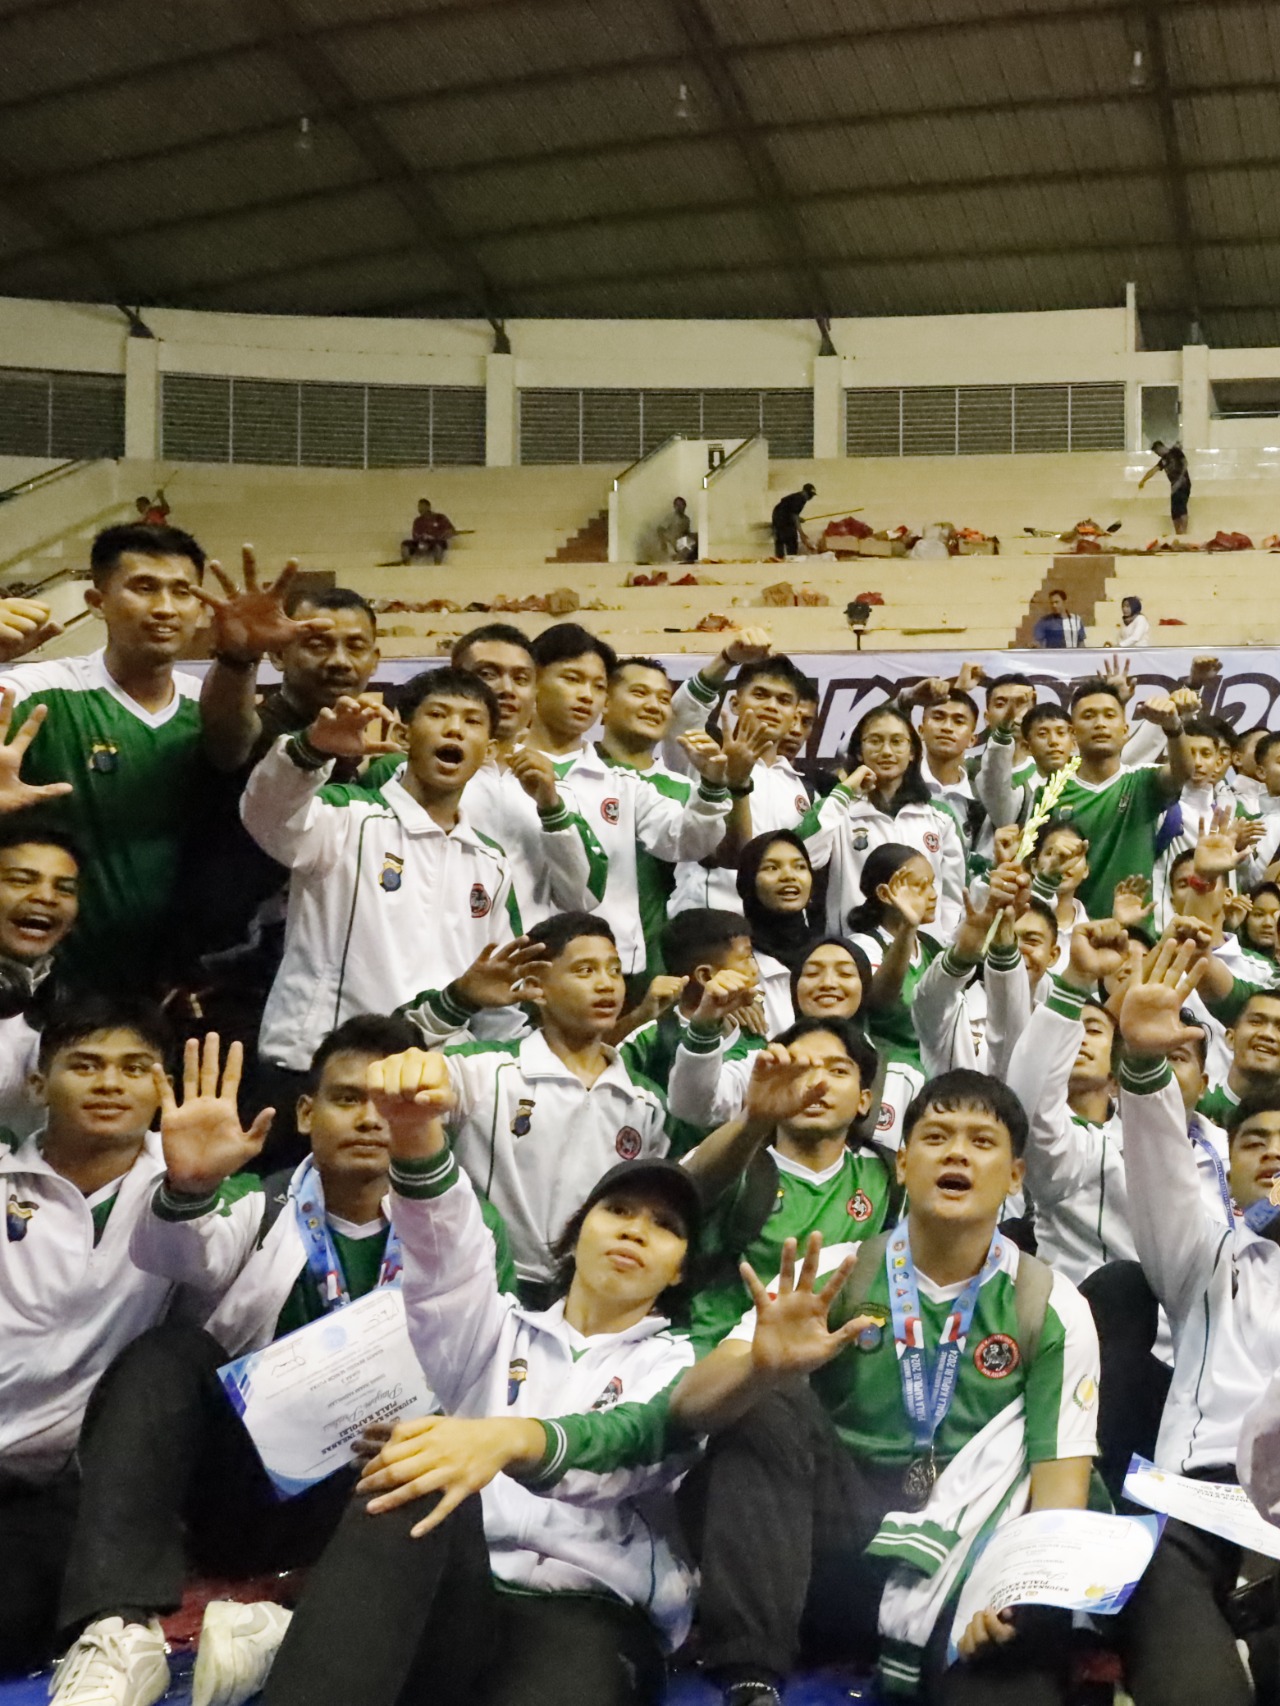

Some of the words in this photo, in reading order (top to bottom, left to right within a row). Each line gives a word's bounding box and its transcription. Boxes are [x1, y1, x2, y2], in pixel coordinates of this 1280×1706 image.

[910, 1353, 921, 1372] 2024
[946, 1350, 958, 1368] 2024
[913, 1373, 924, 1401] KAPOLRI
[939, 1368, 955, 1398] KAPOLRI
[375, 1401, 397, 1417] PIALA
[385, 1396, 417, 1418] KEJURNAS
[915, 1401, 926, 1421] PIALA
[338, 1415, 374, 1438] KAPOLRI
[321, 1433, 356, 1455] INKANAS
